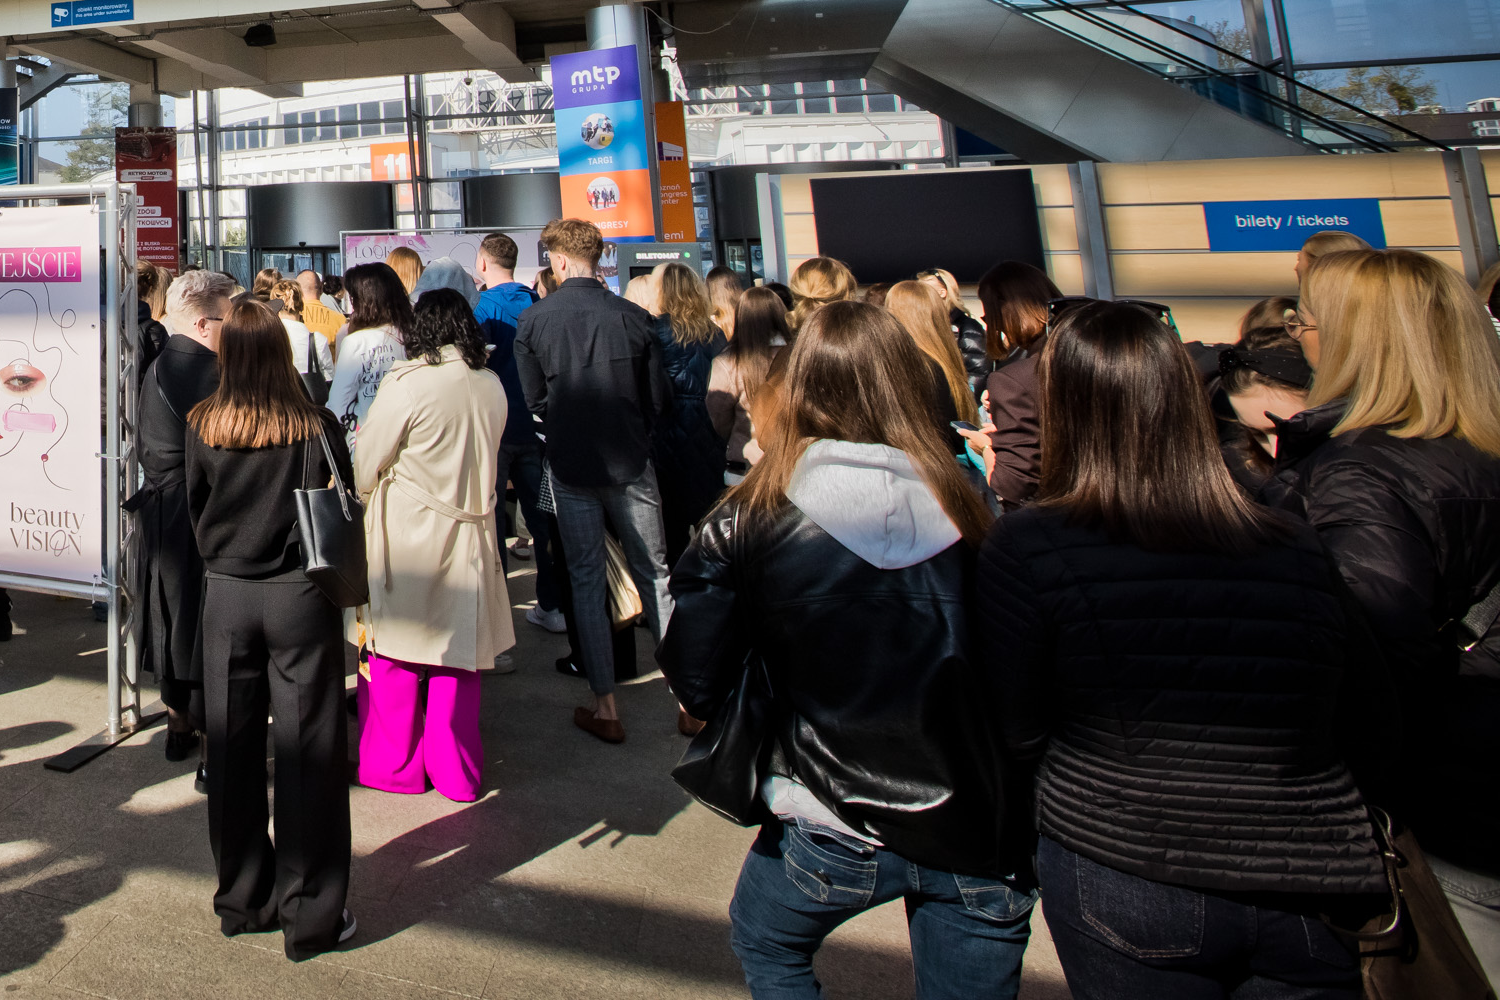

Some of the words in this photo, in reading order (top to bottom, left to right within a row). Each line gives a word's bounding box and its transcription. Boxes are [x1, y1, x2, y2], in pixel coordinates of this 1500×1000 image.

[571, 65, 621, 85] mtp
[572, 85, 605, 94] GRUPA
[588, 156, 613, 166] TARGI
[383, 153, 407, 192] 11
[661, 190, 687, 198] ongress
[596, 220, 629, 230] NGRESY
[1234, 214, 1282, 230] bilety
[1286, 215, 1293, 227] /
[1296, 214, 1349, 226] tickets
[664, 231, 684, 240] emi
[636, 252, 680, 260] BILETOMAT
[11, 501, 85, 535] beauty
[9, 527, 82, 557] VISION
